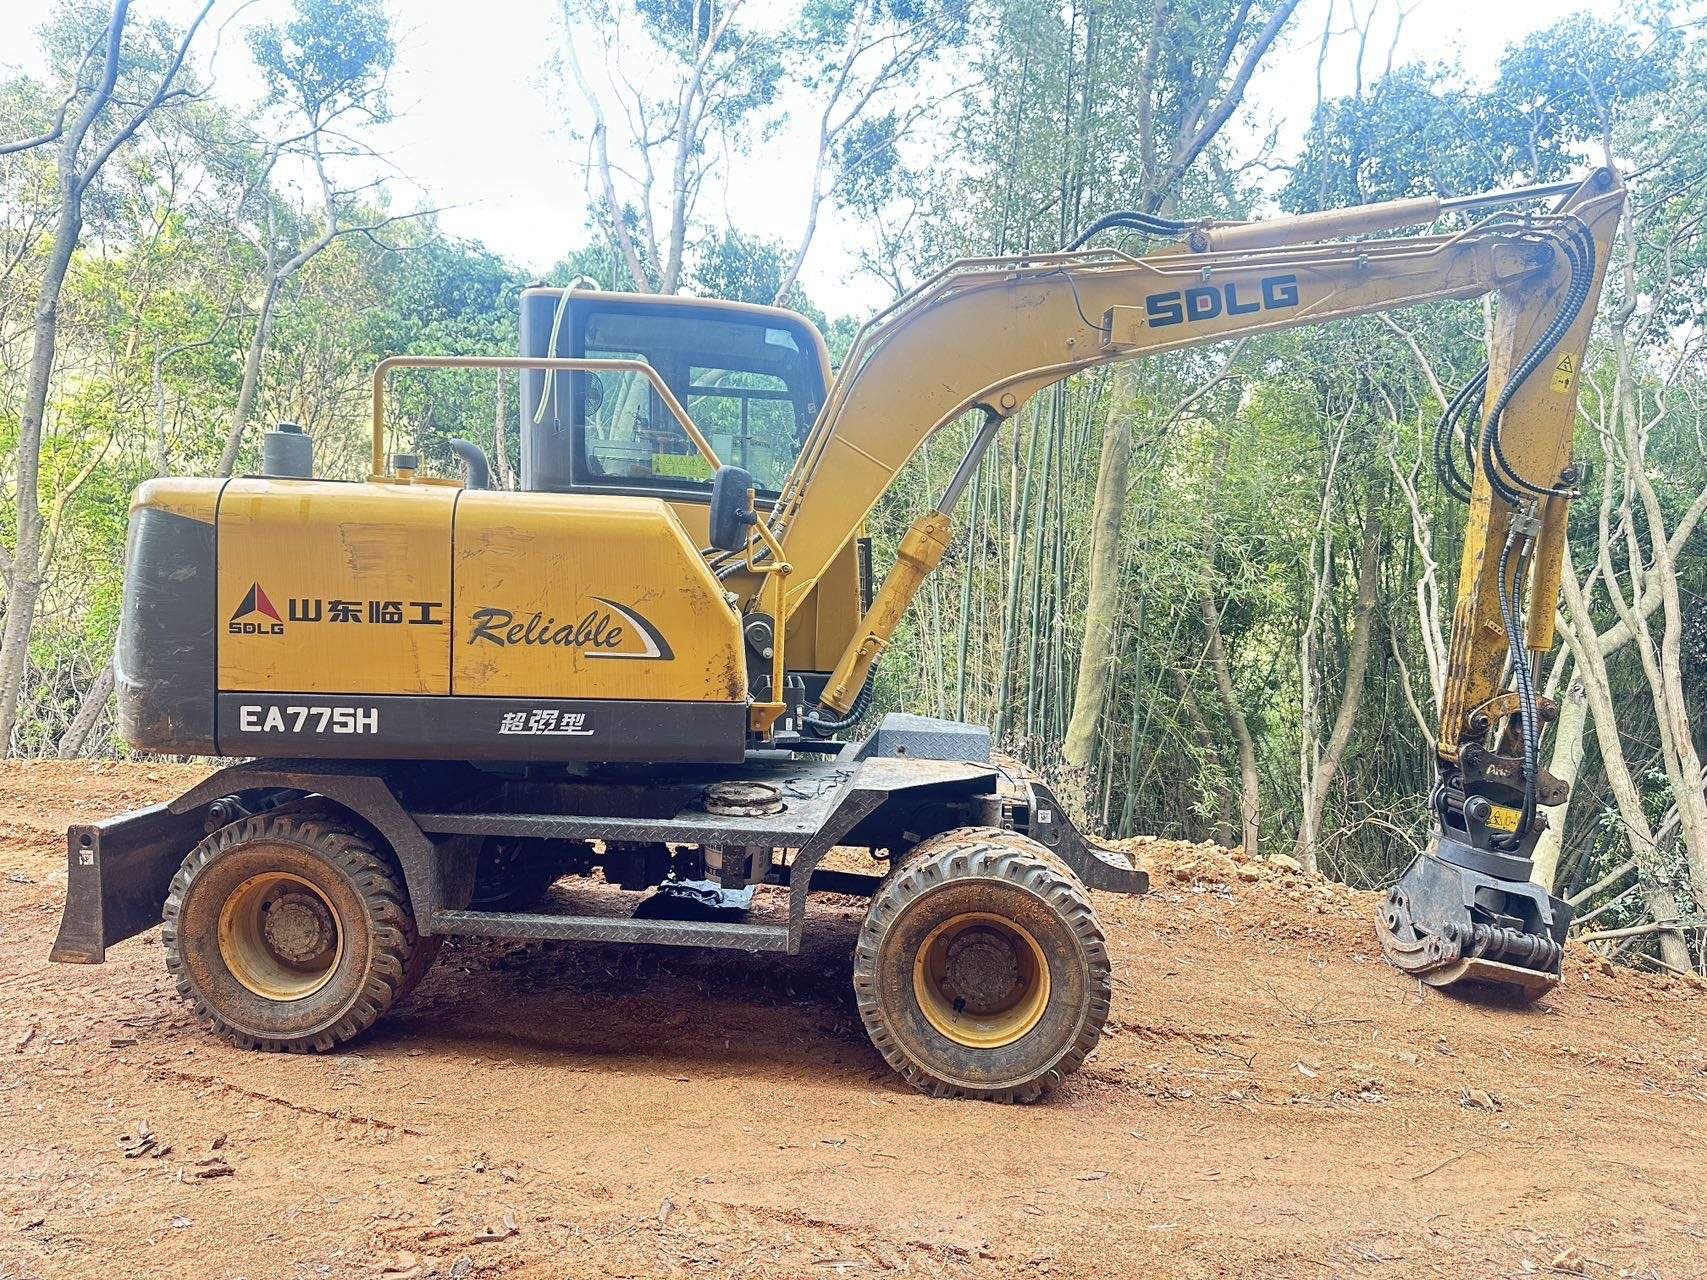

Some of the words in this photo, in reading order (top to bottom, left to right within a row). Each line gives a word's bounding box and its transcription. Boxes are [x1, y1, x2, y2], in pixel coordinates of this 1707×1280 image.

[1146, 275, 1299, 328] SDLG
[288, 598, 443, 625] 山东临工
[229, 623, 284, 635] SDLG
[467, 607, 623, 648] Reliable
[239, 705, 379, 734] EA775H
[498, 709, 594, 736] 超强型
